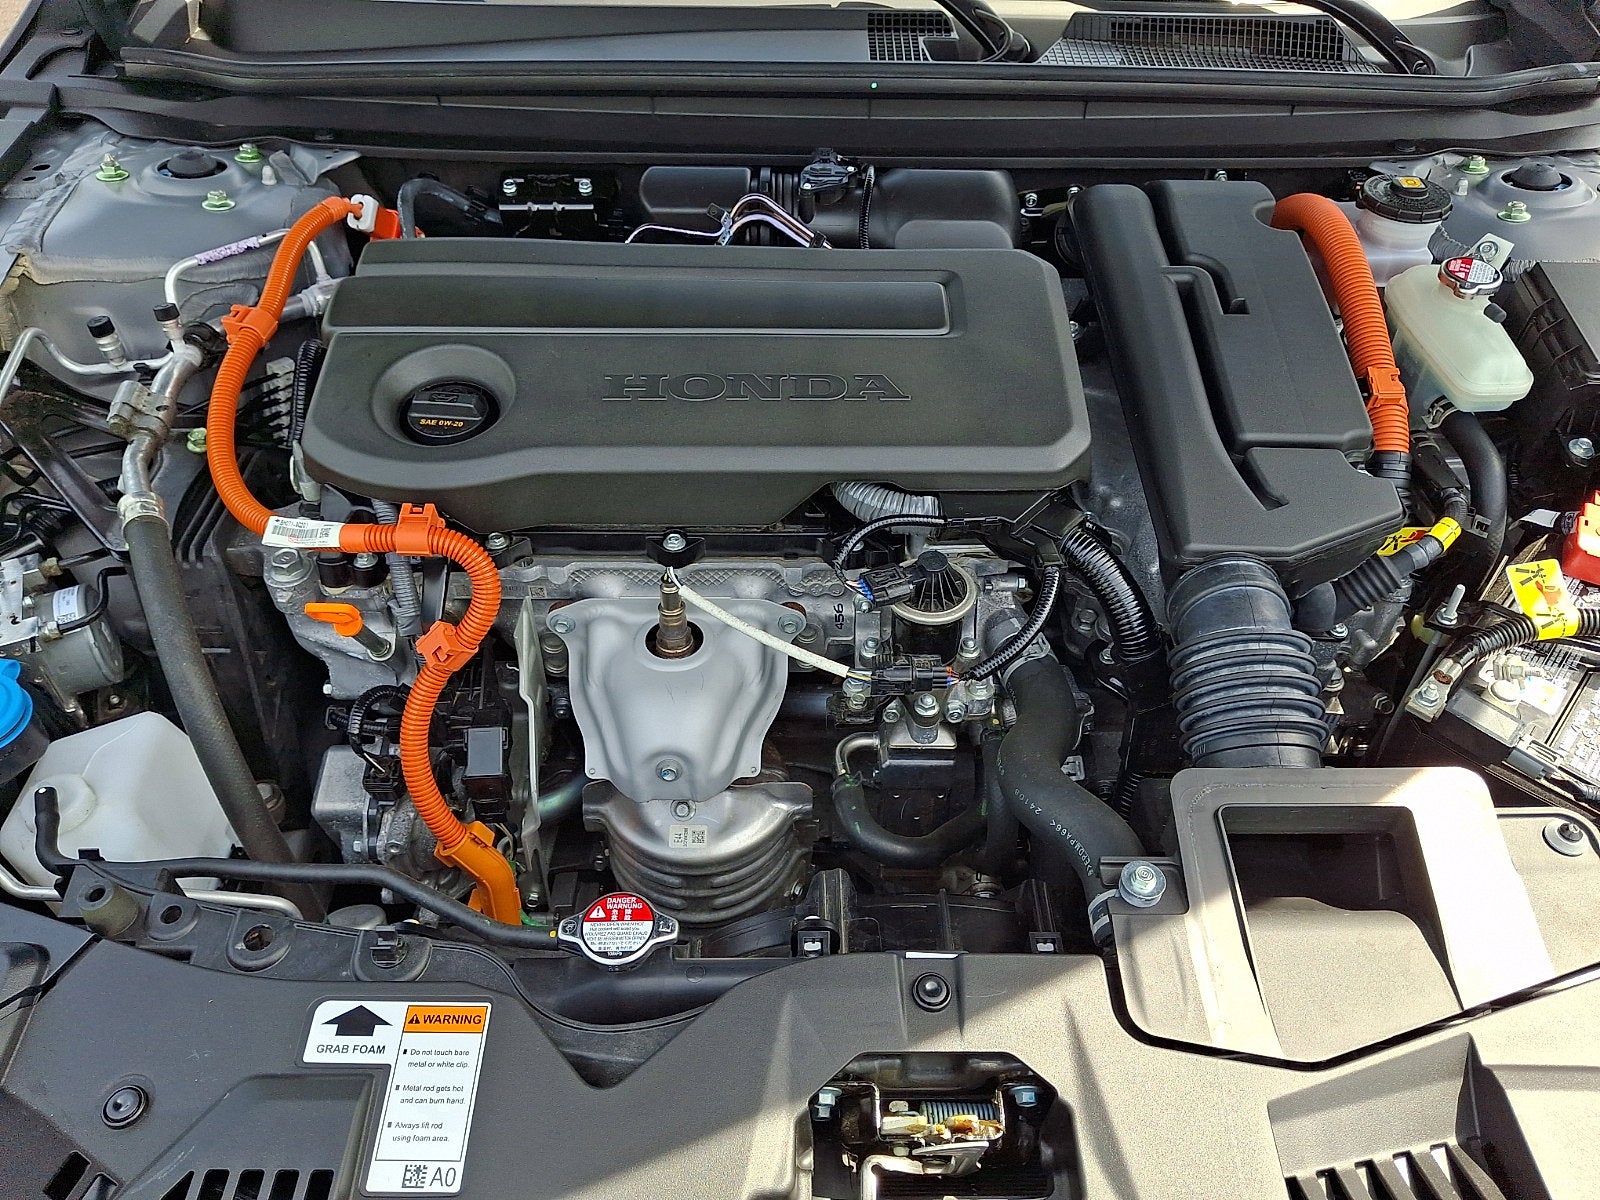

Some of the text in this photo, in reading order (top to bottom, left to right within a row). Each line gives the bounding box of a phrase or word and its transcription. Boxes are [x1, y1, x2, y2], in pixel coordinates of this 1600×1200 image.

[602, 373, 912, 402] HONDA
[419, 418, 437, 426] SAE
[833, 603, 845, 630] 456
[422, 1014, 482, 1026] WARNING
[316, 1044, 386, 1055] GRAB FOAM
[455, 1061, 470, 1069] clip.
[435, 1085, 451, 1093] gets
[394, 1121, 420, 1130] Always
[420, 1121, 430, 1129] lift
[392, 1135, 412, 1143] using
[428, 1166, 457, 1188] A0
